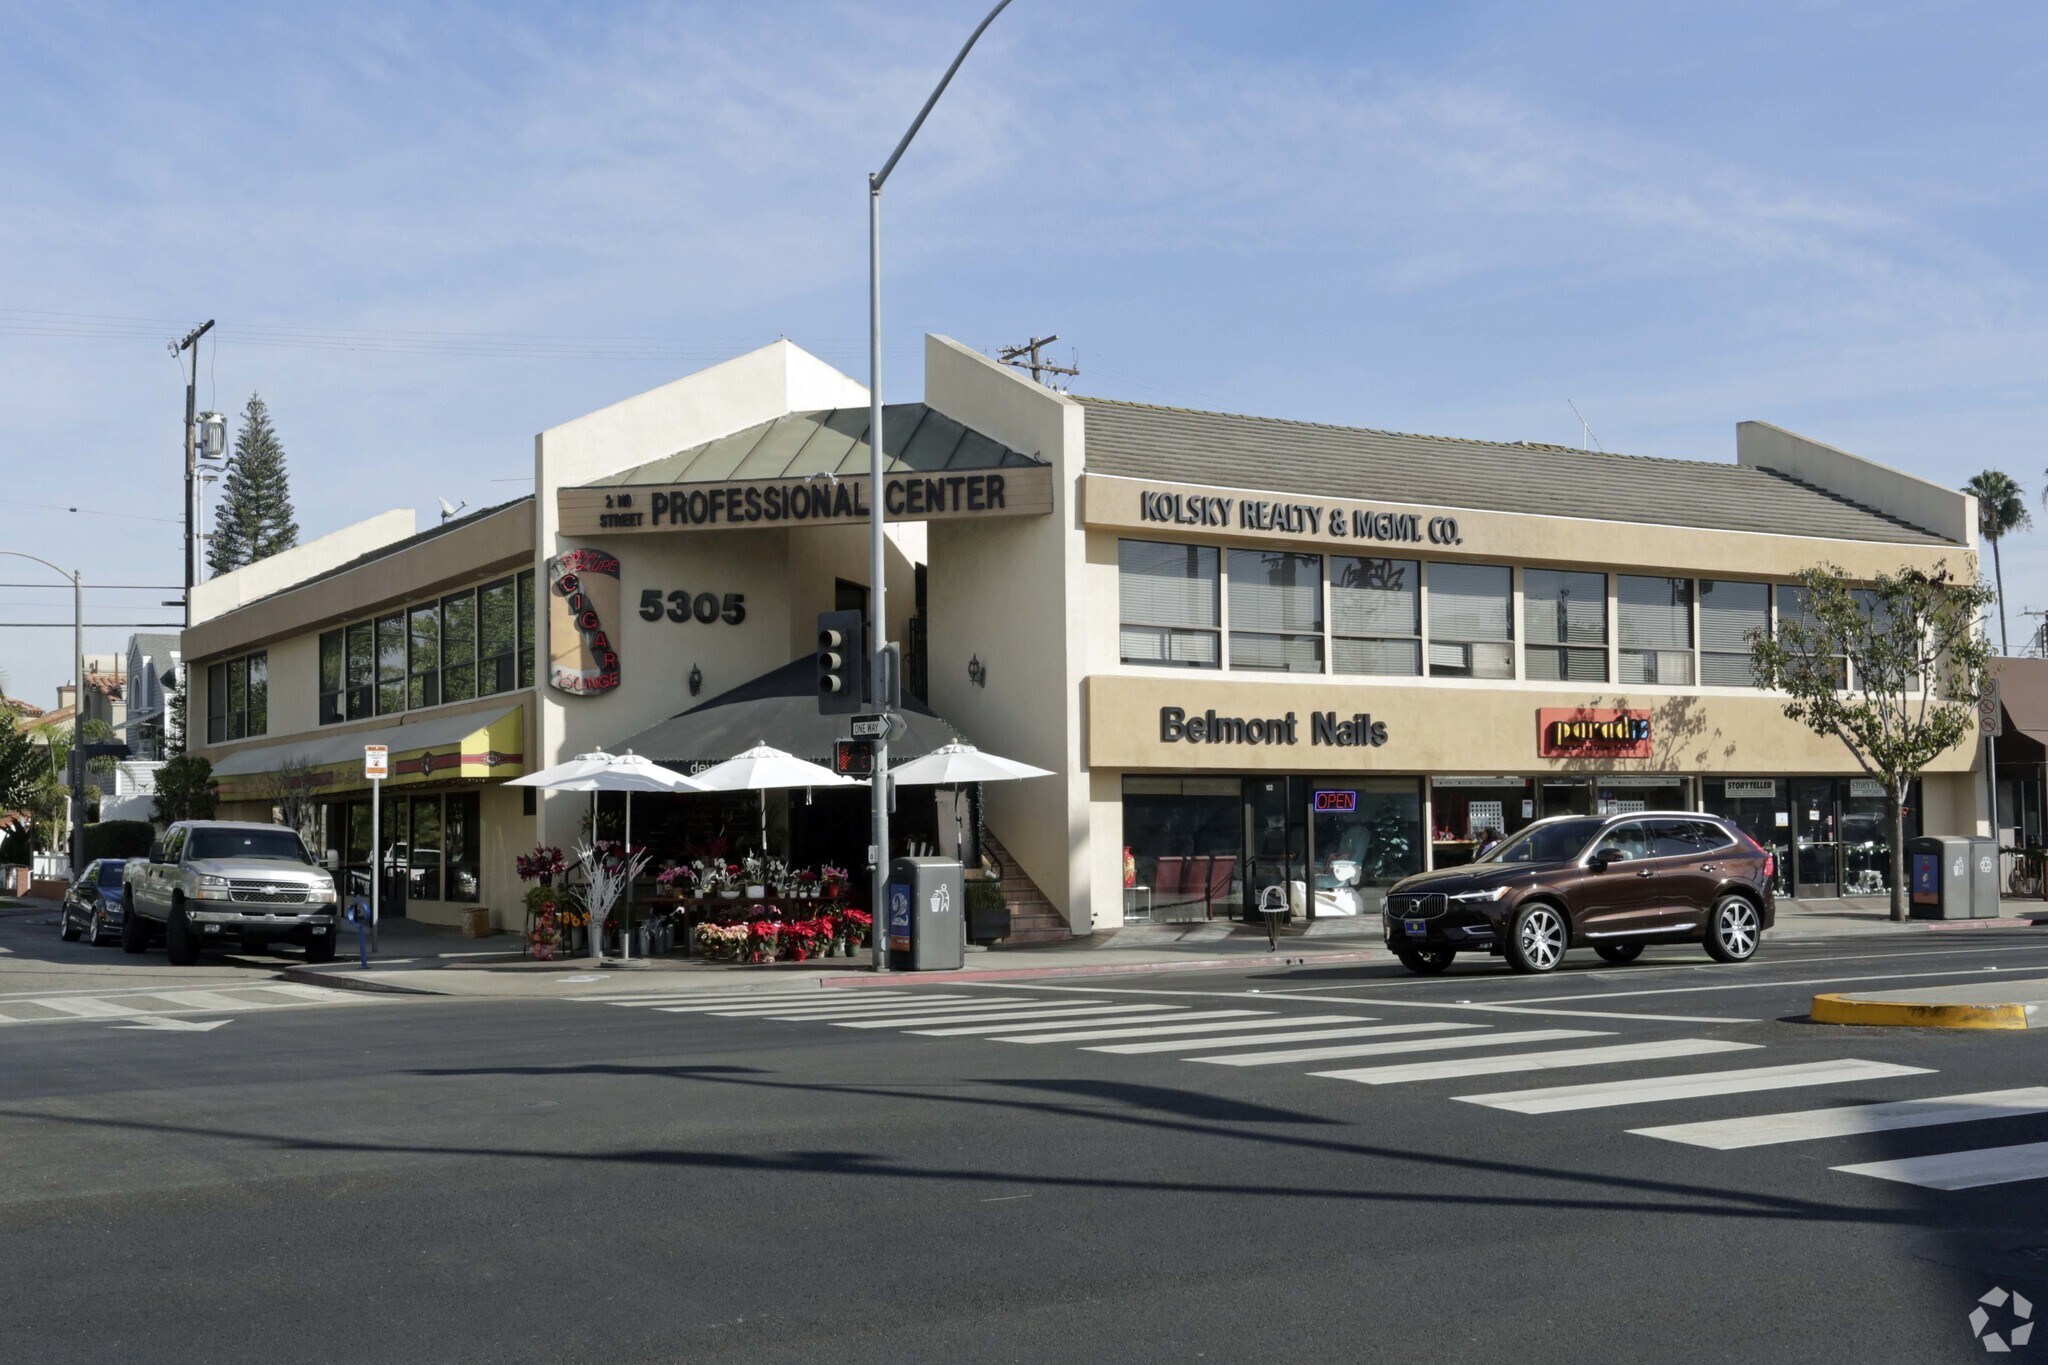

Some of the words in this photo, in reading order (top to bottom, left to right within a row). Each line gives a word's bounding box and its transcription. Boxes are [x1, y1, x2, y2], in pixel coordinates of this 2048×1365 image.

[605, 494, 614, 508] 2
[617, 493, 633, 508] ND
[651, 481, 871, 526] PROFESSIONAL
[885, 474, 1006, 515] CENTER
[599, 512, 643, 528] STREET
[1140, 490, 1234, 528] KOLSKY
[1239, 499, 1324, 535] REALTY
[1328, 507, 1348, 537] &
[1352, 509, 1425, 543] MGMT.
[1427, 515, 1463, 546] CO.
[639, 590, 746, 625] 5305
[561, 573, 619, 671] CIGAR
[556, 670, 620, 692] LOUNGE
[854, 723, 866, 734] ONE
[867, 722, 879, 732] WAY
[1160, 706, 1298, 745] Belmont
[1311, 711, 1389, 748] Nails
[1554, 715, 1649, 746] paradis
[1727, 781, 1773, 790] STORYTELLER
[1317, 793, 1354, 809] OPEN
